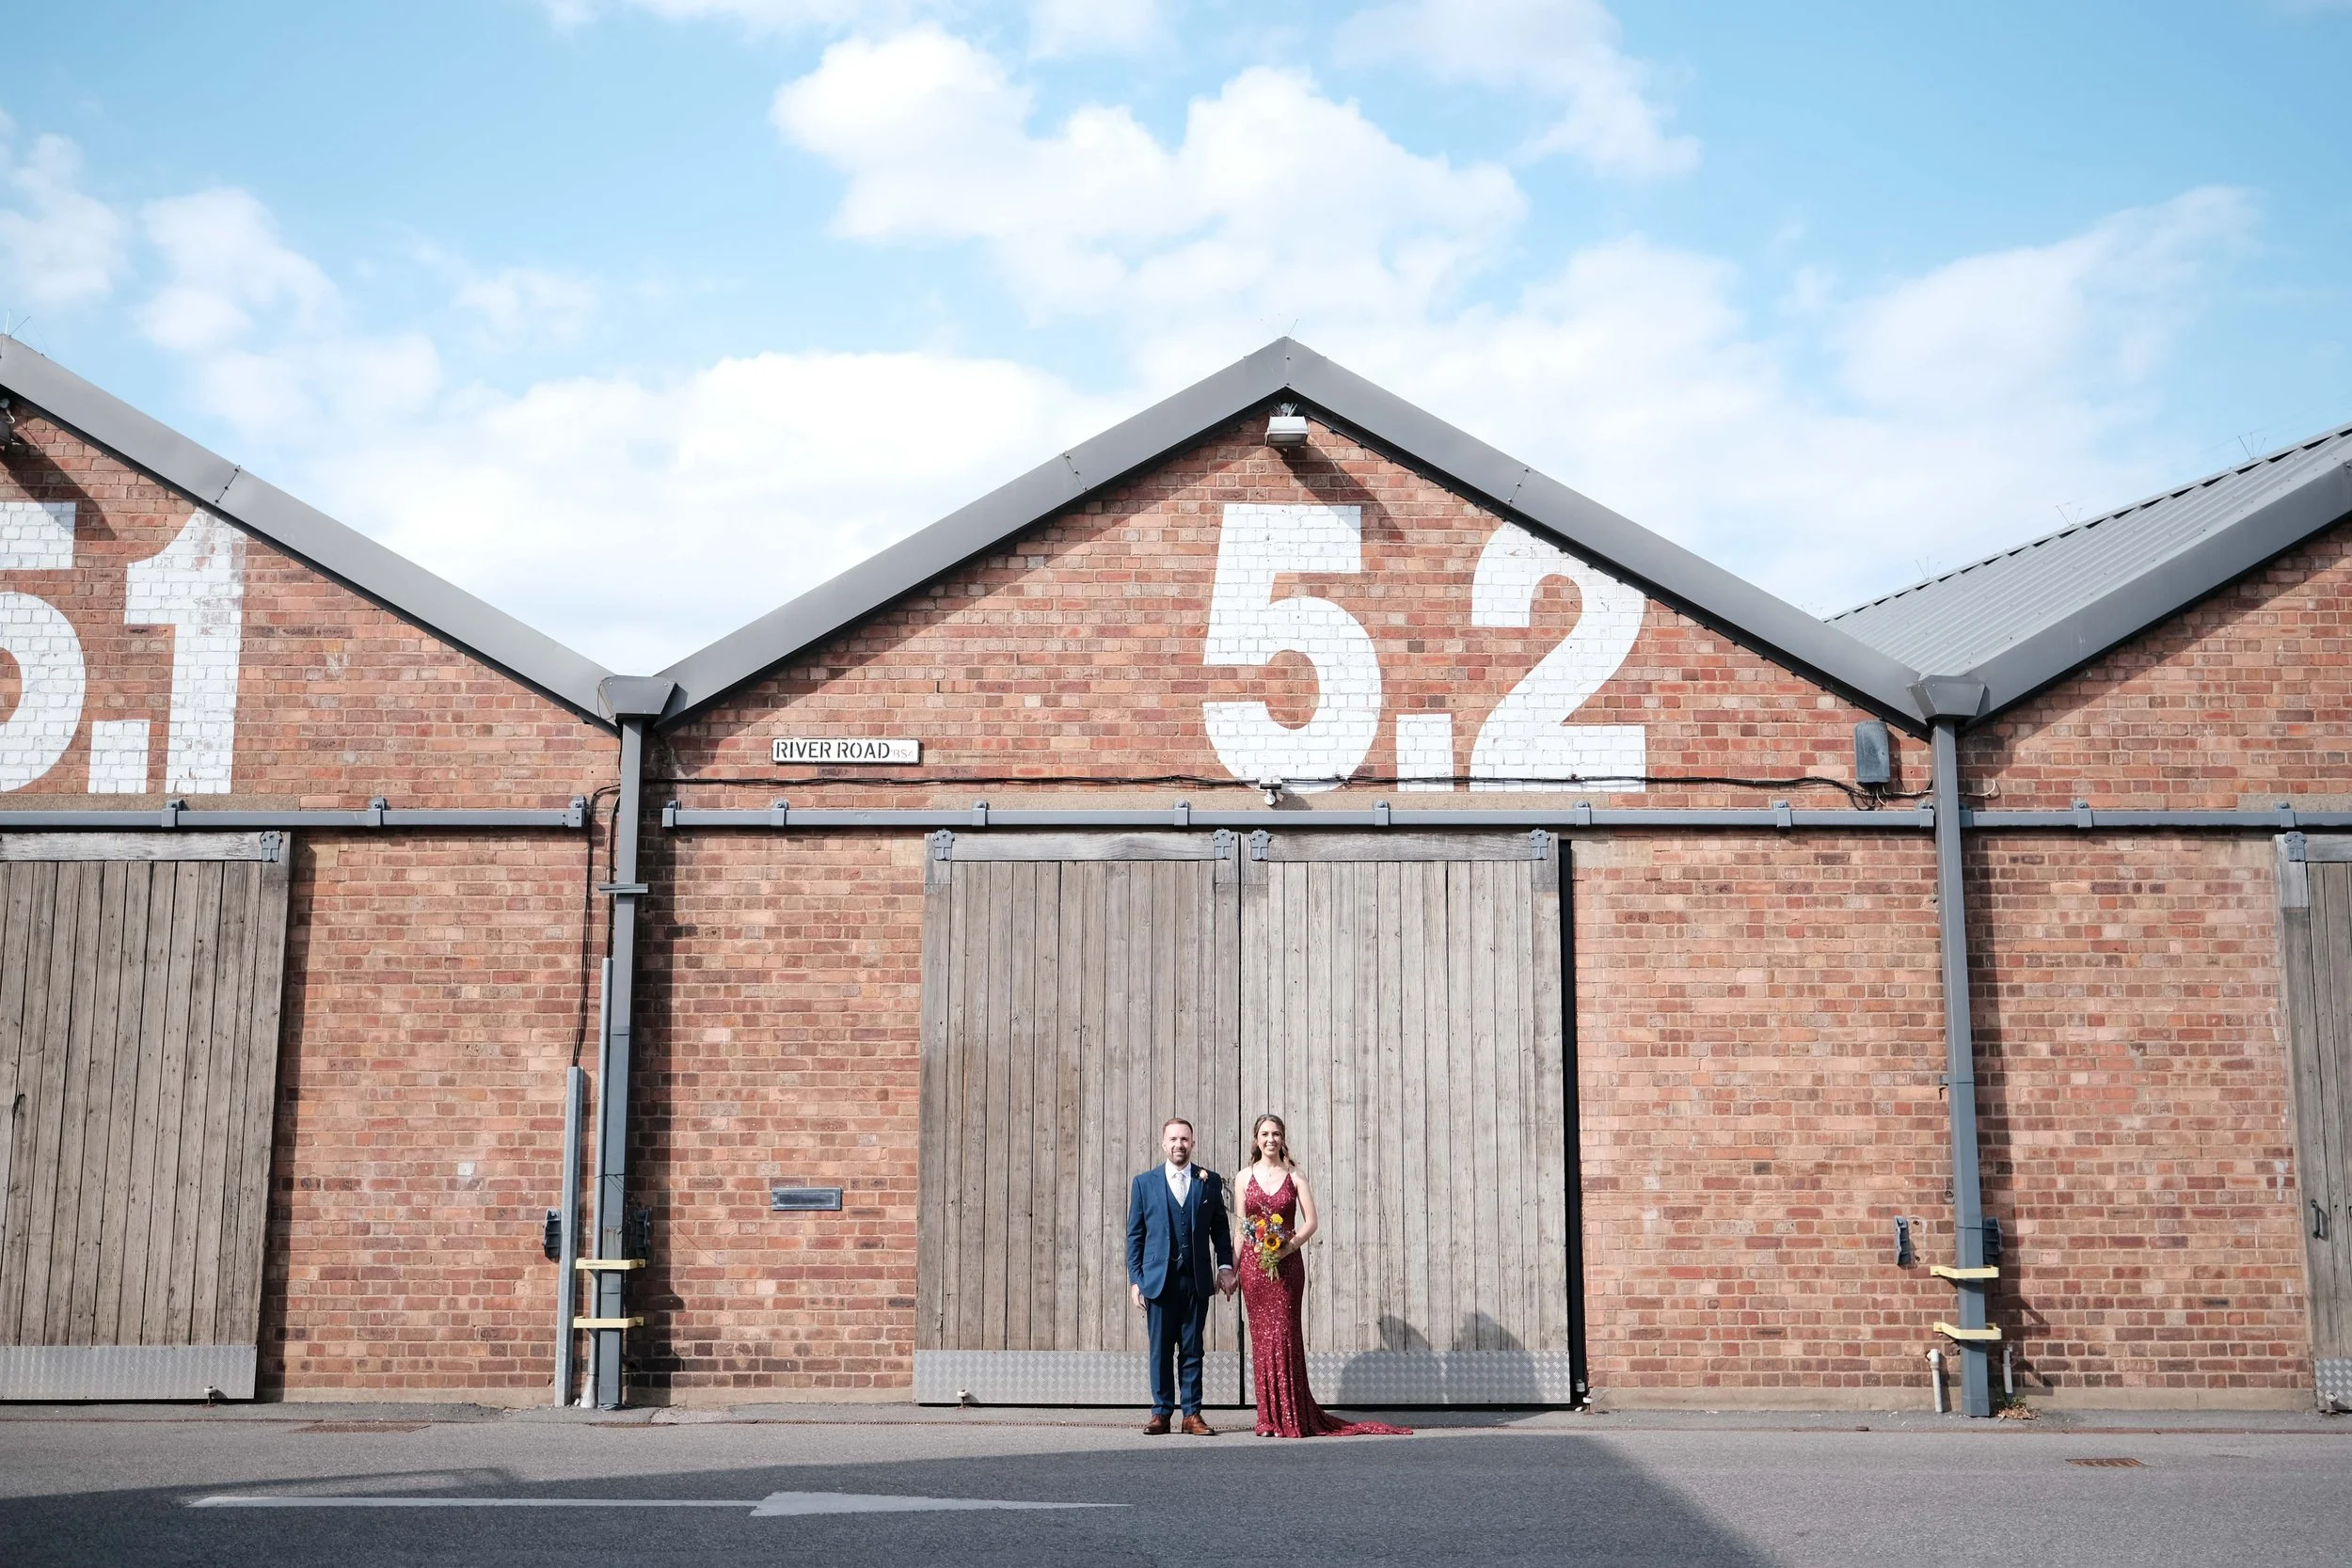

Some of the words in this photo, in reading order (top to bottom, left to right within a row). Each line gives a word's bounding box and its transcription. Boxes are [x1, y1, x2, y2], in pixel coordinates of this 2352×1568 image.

[1202, 503, 1645, 793] 5.2
[776, 741, 832, 758] RIVER
[837, 741, 890, 759] ROAD
